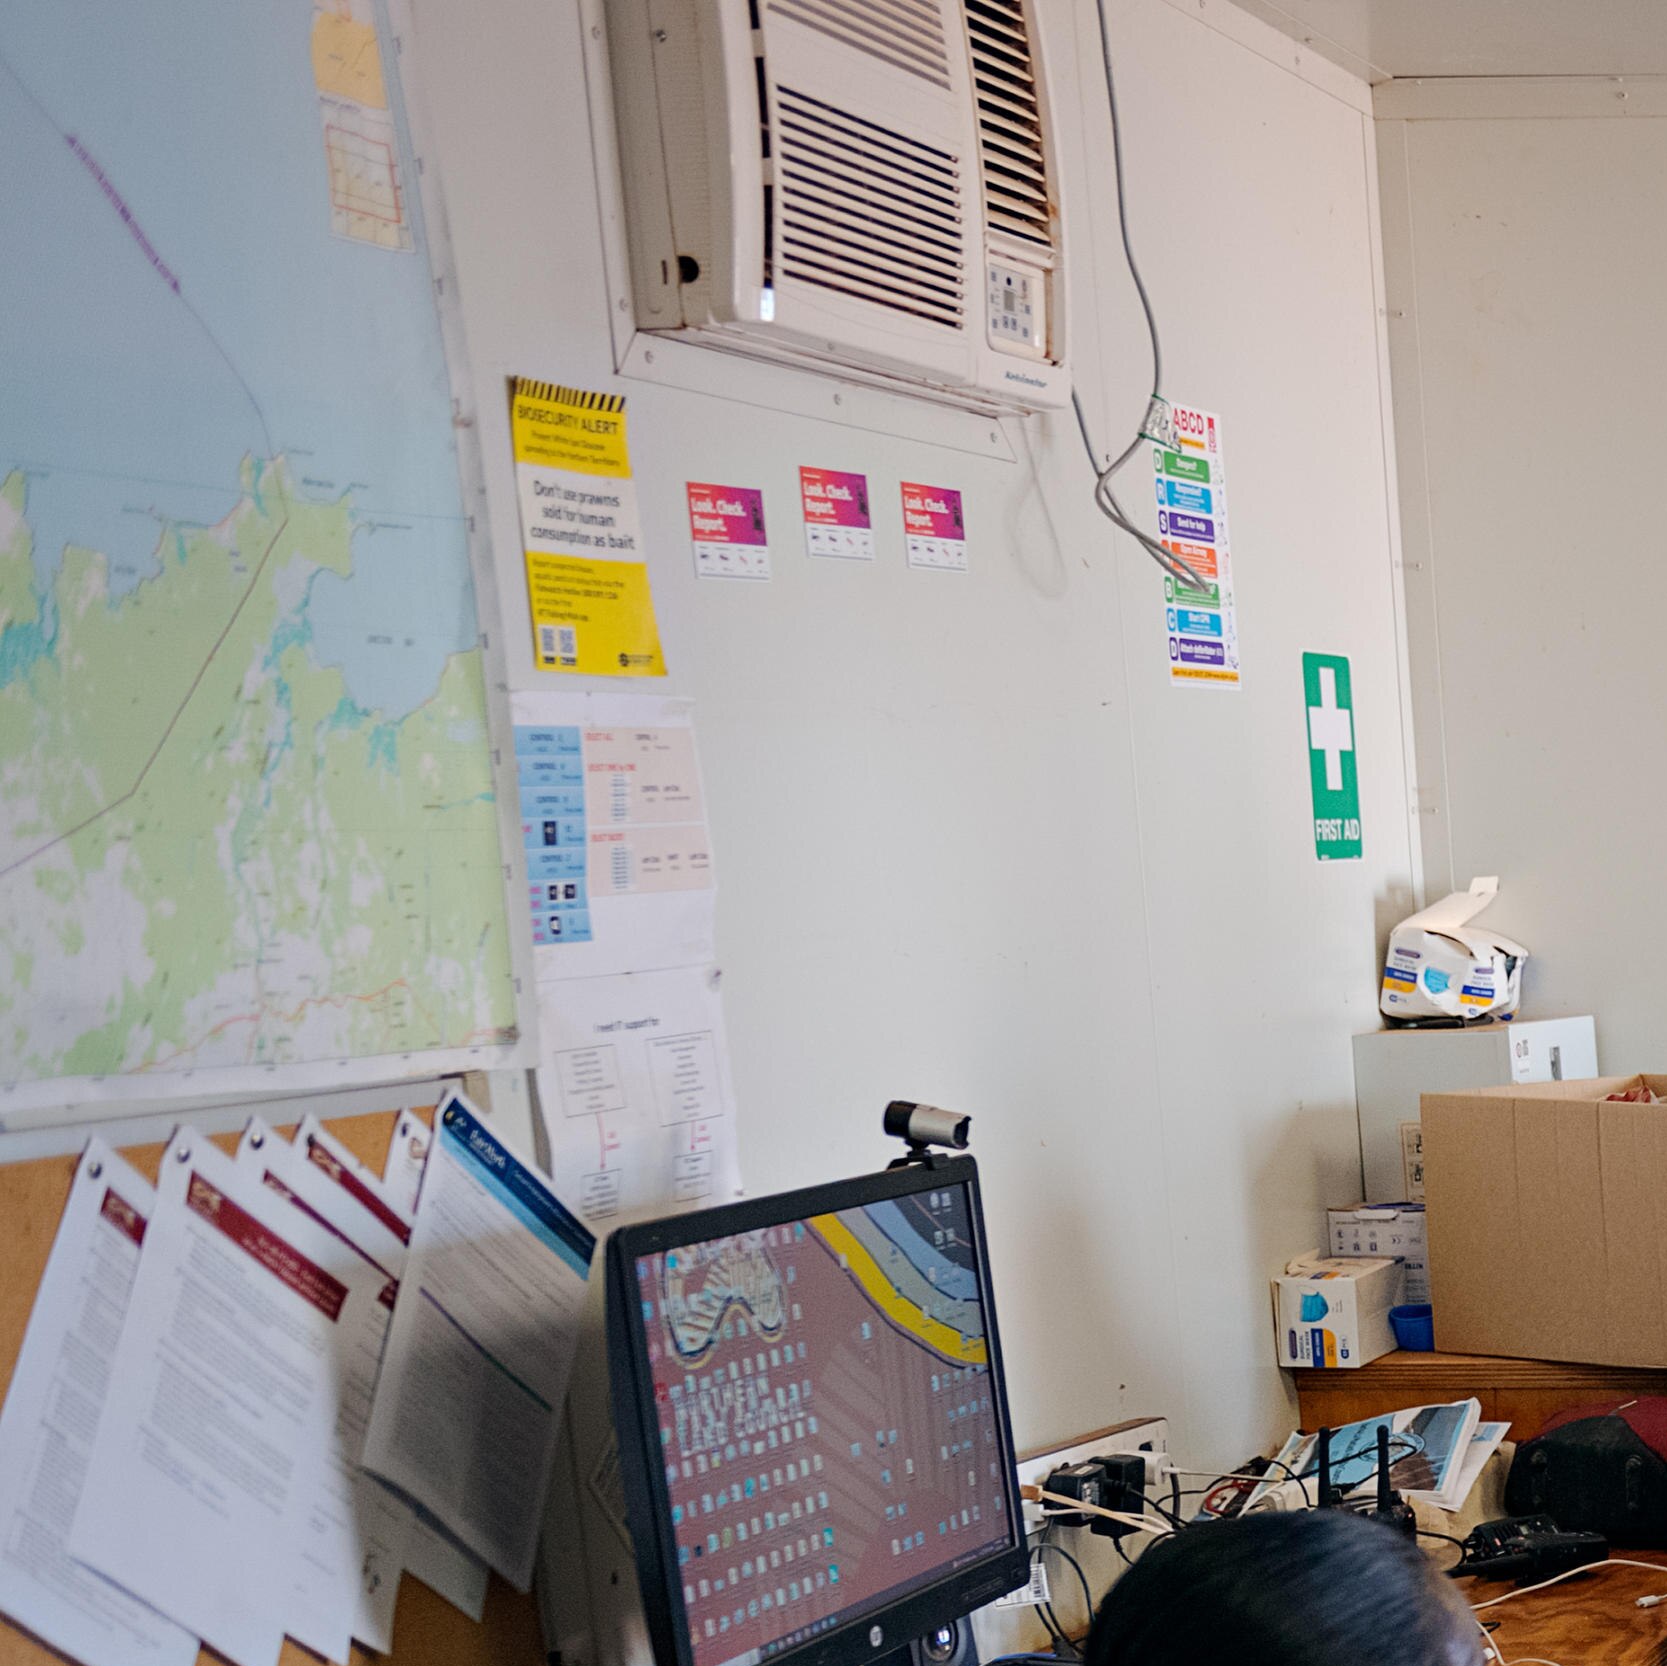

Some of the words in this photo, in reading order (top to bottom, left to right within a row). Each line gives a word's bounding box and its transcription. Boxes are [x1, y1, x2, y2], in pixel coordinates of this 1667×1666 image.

[517, 404, 579, 430] BIOSECURITY
[581, 418, 619, 435] ALERT
[608, 534, 635, 550] bait
[1315, 818, 1343, 841] FIRST
[1343, 818, 1360, 841] AID
